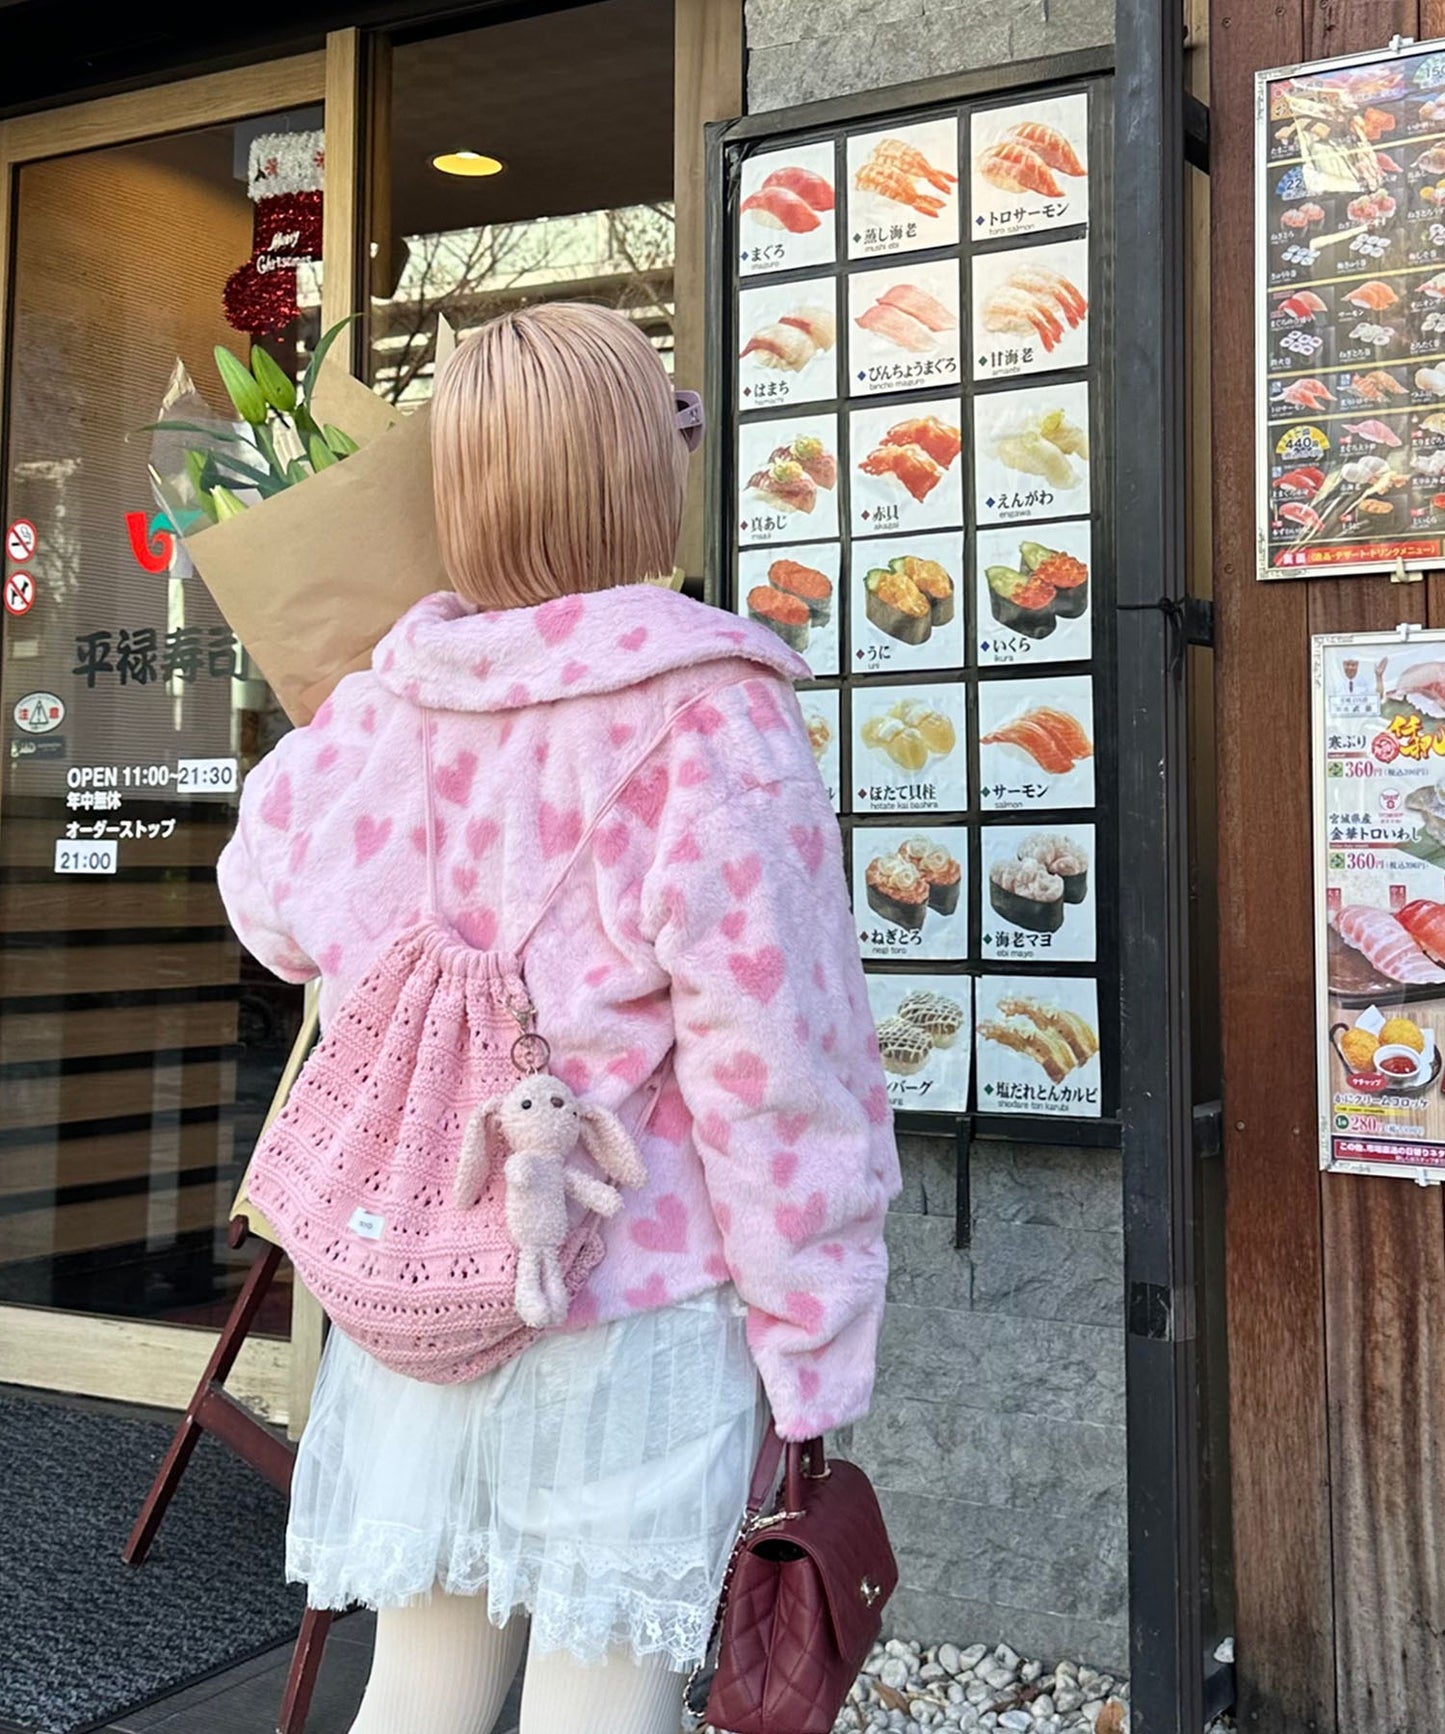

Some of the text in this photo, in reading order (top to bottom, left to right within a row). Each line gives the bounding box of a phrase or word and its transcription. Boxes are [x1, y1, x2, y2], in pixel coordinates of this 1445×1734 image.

[989, 203, 1070, 226] トロサーモン
[864, 222, 917, 244] 蒸し海老
[751, 244, 785, 262] まぐろ
[991, 347, 1033, 367] 甘海老
[868, 357, 957, 382] びんちょうまぐろ
[754, 380, 789, 398] はまち
[997, 490, 1054, 509] えんがわ
[873, 504, 899, 521] 赤貝
[751, 515, 787, 532] 真あじ
[868, 645, 891, 661] うに
[993, 637, 1031, 652] いくら
[72, 627, 249, 689] 平禄寿司
[67, 766, 117, 788] OPEN
[66, 791, 122, 811] 年中無休
[870, 784, 937, 800] ほたて貝柱
[992, 784, 1048, 800] サーモン
[66, 819, 177, 840] オーダーストップ
[1329, 827, 1421, 841] 金華トロいわし
[60, 851, 111, 870] 21:00
[871, 931, 922, 946] ねぎとろ
[995, 931, 1052, 948] 海老マヨ
[996, 1081, 1098, 1103] 塩だれとんカルビ
